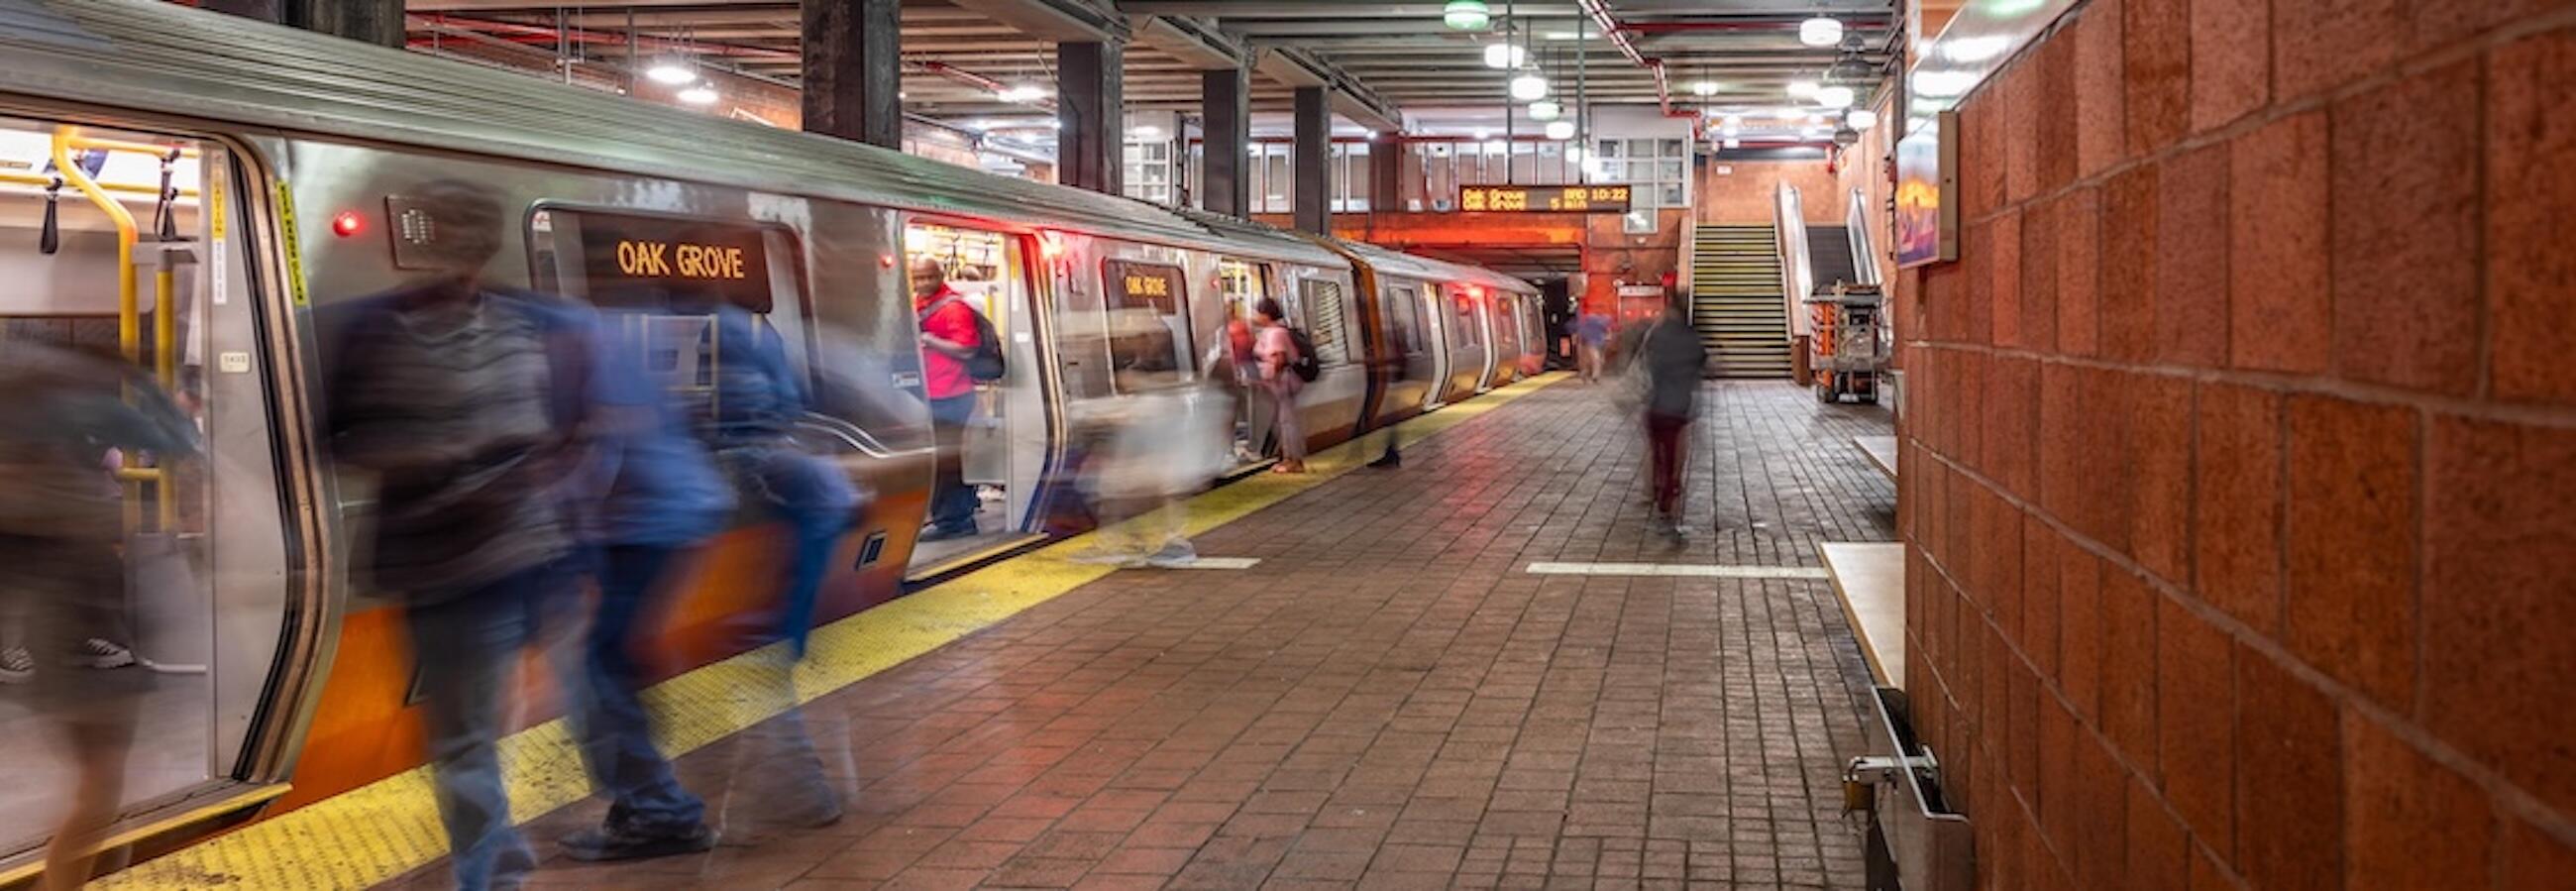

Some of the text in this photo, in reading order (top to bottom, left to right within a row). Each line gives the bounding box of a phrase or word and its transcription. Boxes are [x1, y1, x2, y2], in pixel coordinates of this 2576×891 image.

[1462, 188, 1484, 199] Oak
[1489, 188, 1526, 199] Grove
[1591, 188, 1628, 200] 10:22
[1462, 198, 1587, 210] Oak Grove 5 min
[616, 240, 745, 278] OAK GROVE
[1125, 276, 1167, 296] OAK GROVE
